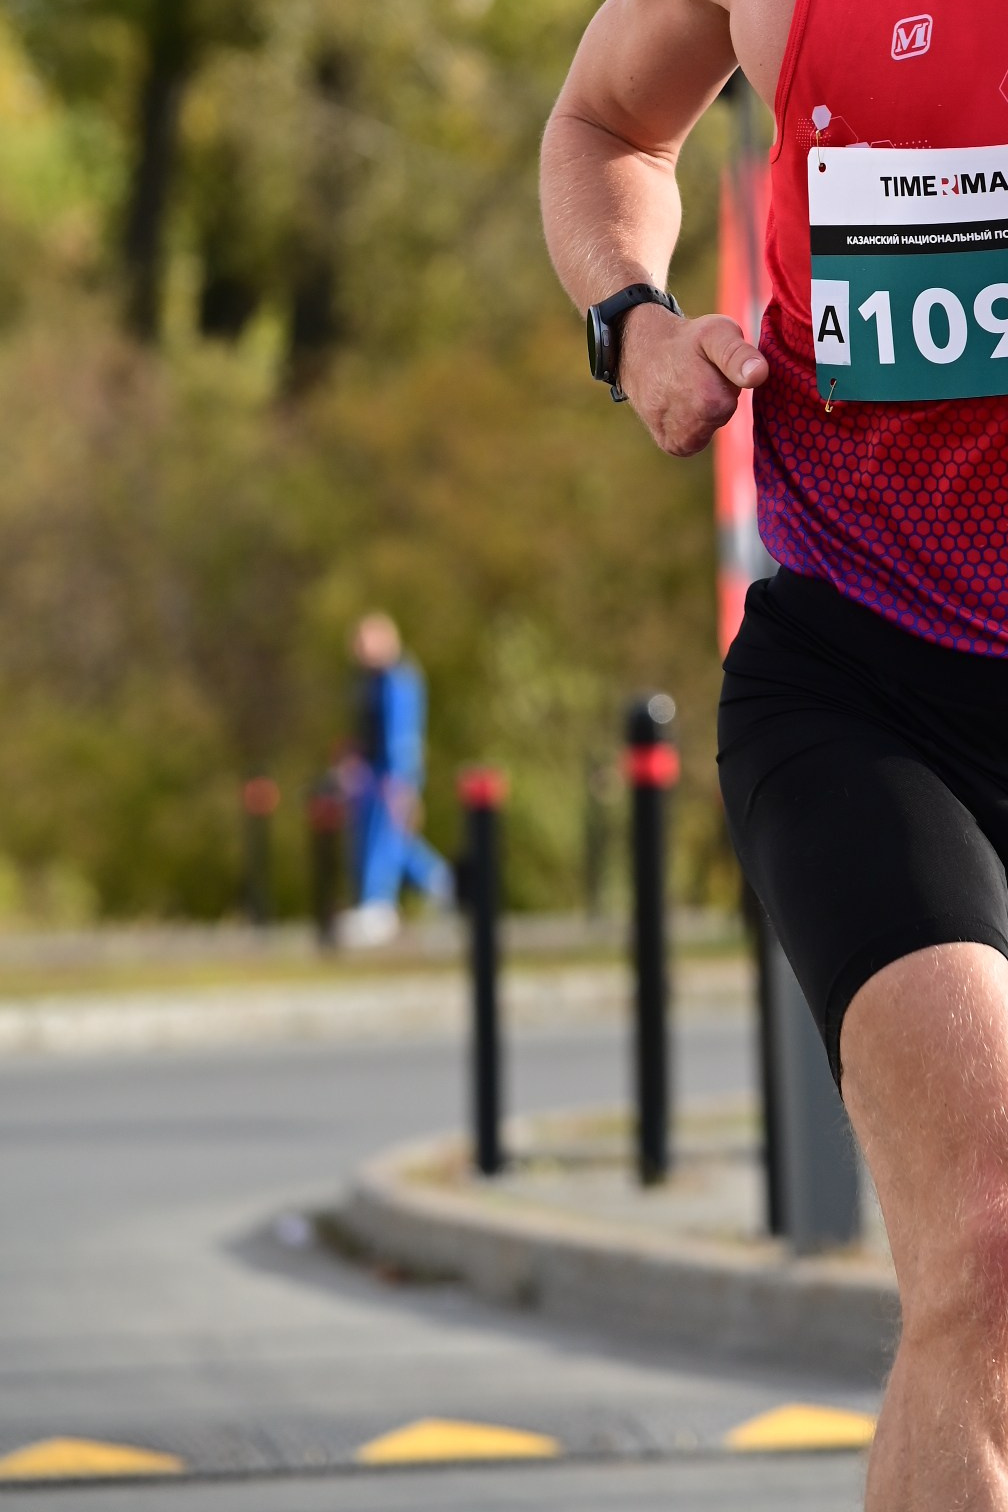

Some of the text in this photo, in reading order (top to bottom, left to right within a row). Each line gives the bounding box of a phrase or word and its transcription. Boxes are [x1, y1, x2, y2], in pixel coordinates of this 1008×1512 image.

[846, 233, 900, 245] КАЗАНСКИЙ
[901, 229, 992, 245] НАЦИОНАЛЬНЫЙ
[816, 305, 846, 344] A
